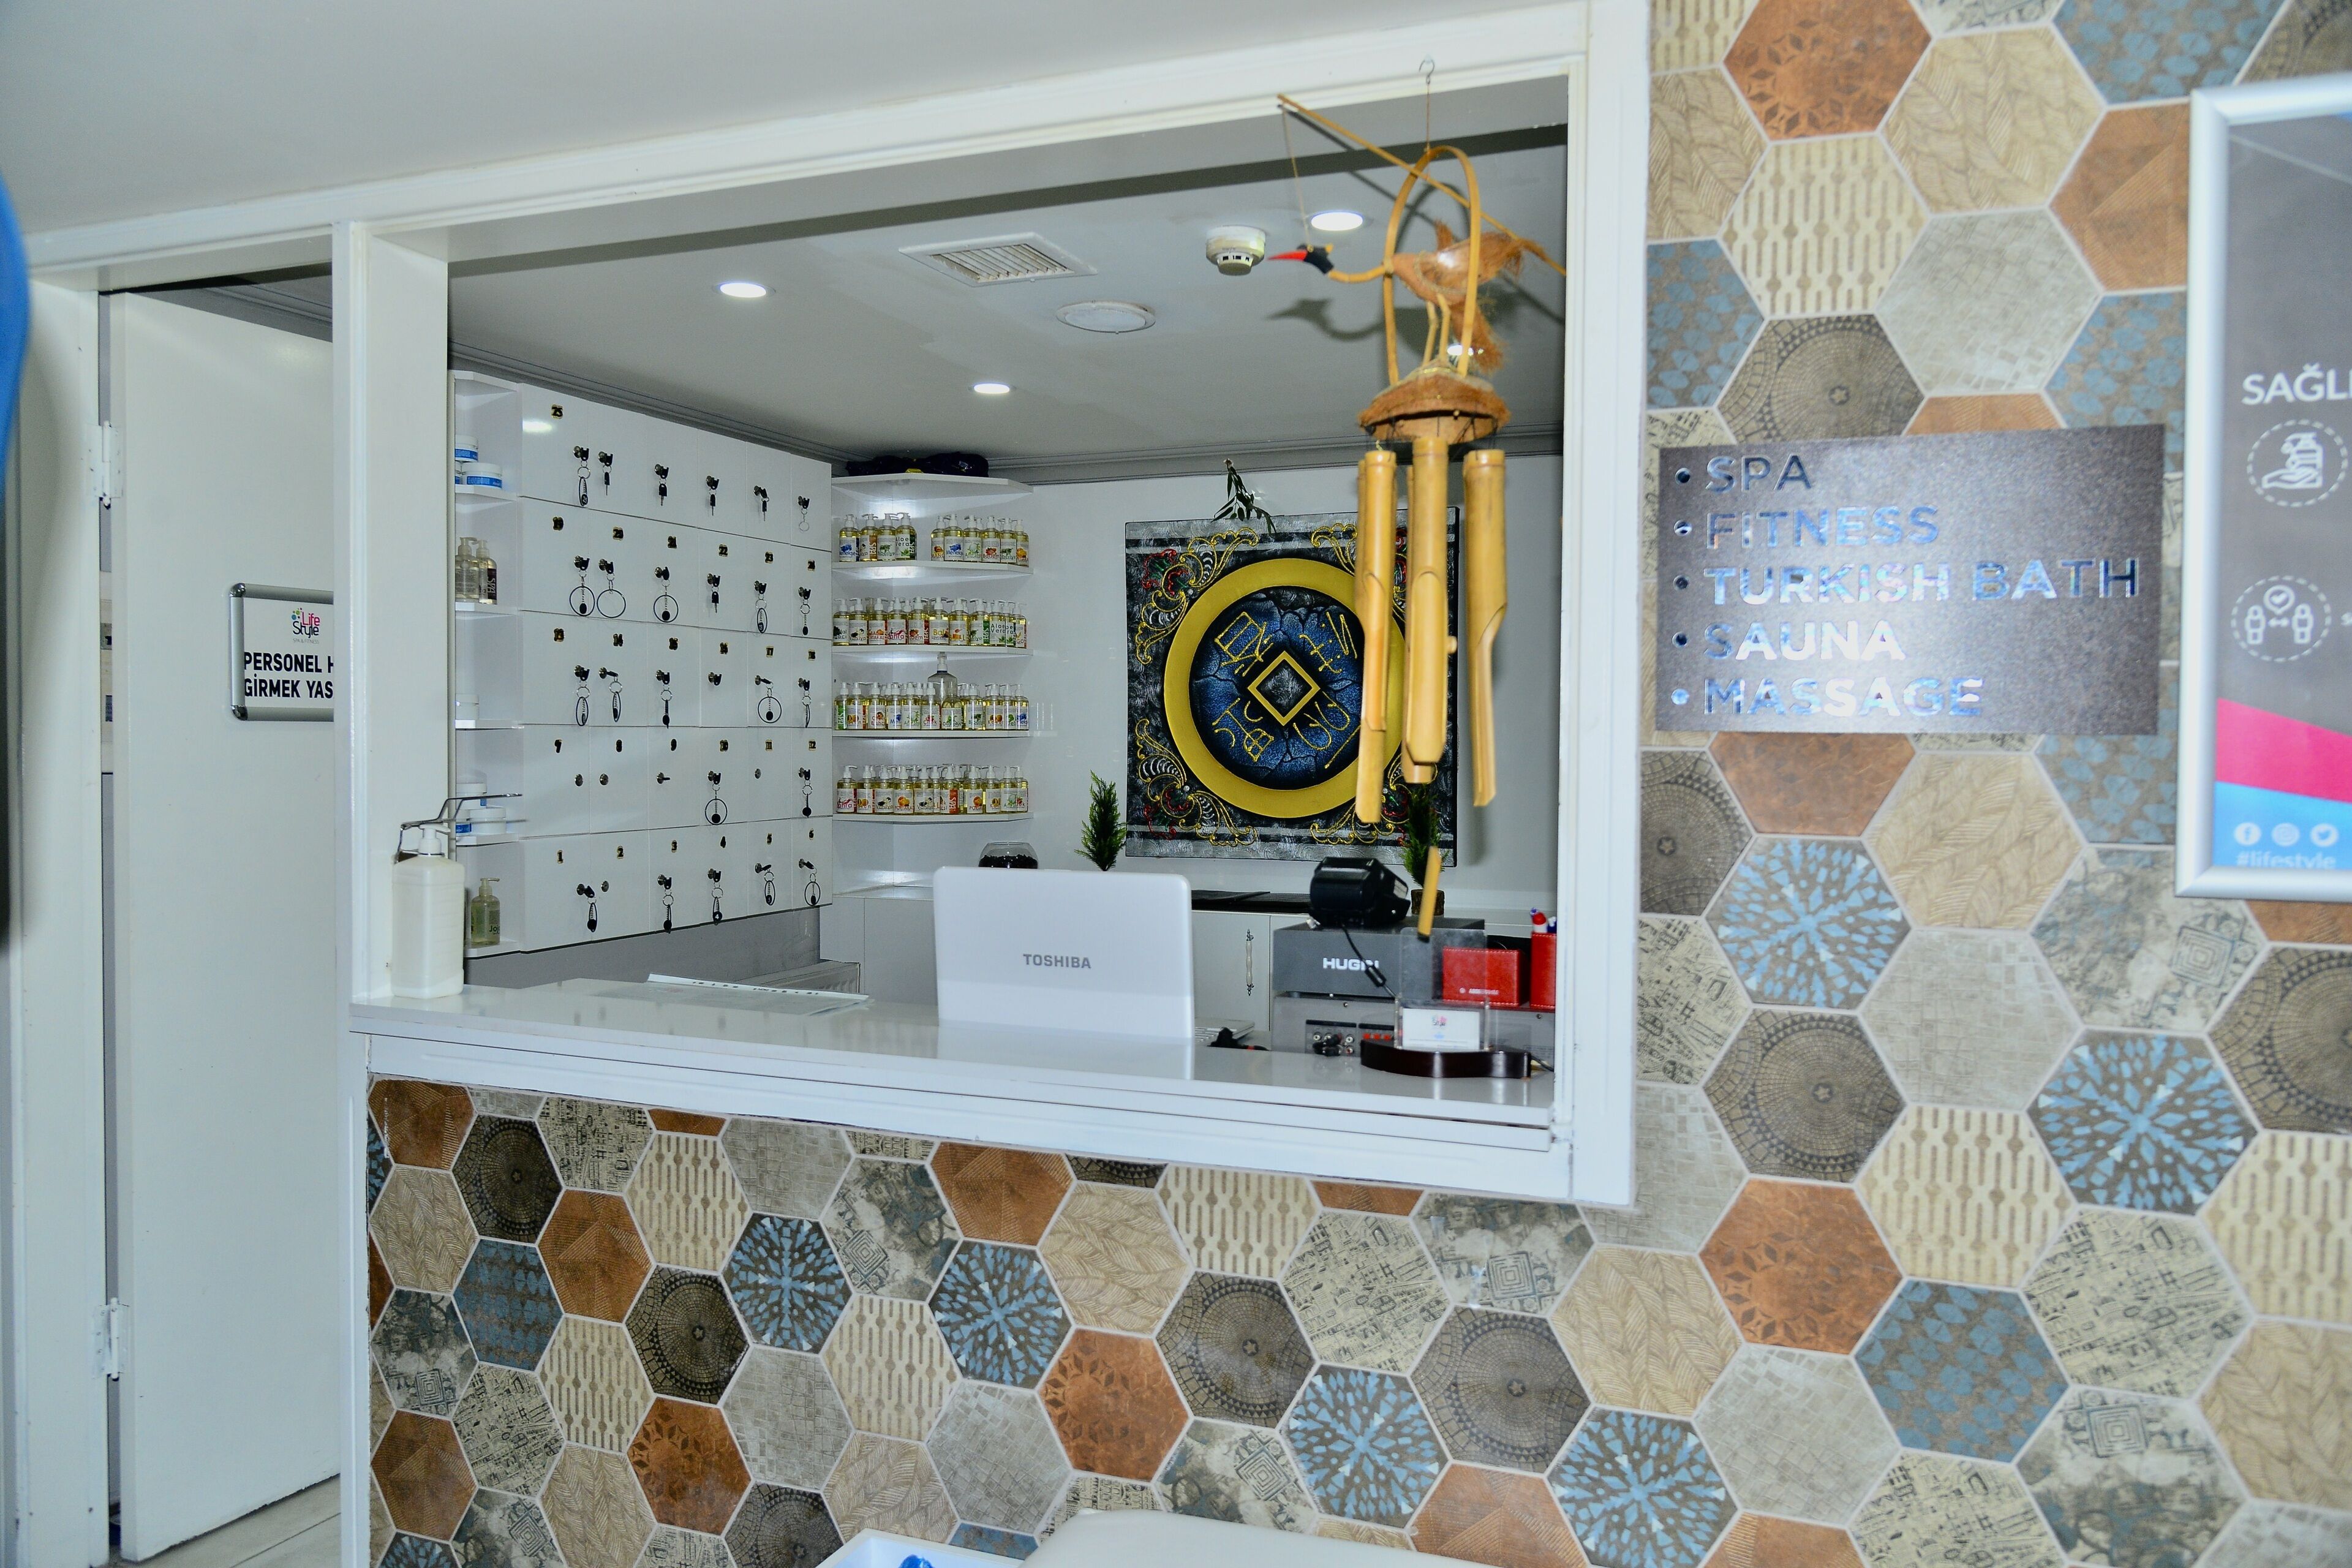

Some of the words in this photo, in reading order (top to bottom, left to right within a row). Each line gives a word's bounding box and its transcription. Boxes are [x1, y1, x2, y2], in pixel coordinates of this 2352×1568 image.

[1705, 454, 1813, 494] SPA
[1706, 505, 1939, 548] FITNESS
[1703, 562, 1950, 605] TURKISH
[1972, 558, 2139, 601] BATH
[302, 611, 320, 627] Life
[293, 620, 319, 638] Style
[1704, 620, 1905, 661] SAUNA
[244, 651, 322, 673] PERSONEL
[244, 673, 301, 698] GİRMEK
[1704, 676, 1984, 717] MASSAGE
[720, 836, 726, 848] 4
[767, 832, 772, 845] 5
[809, 829, 814, 840] 6
[617, 845, 624, 859] 2
[671, 840, 677, 852] 3
[557, 850, 564, 864] 1
[1023, 953, 1091, 969] TOSHIBA
